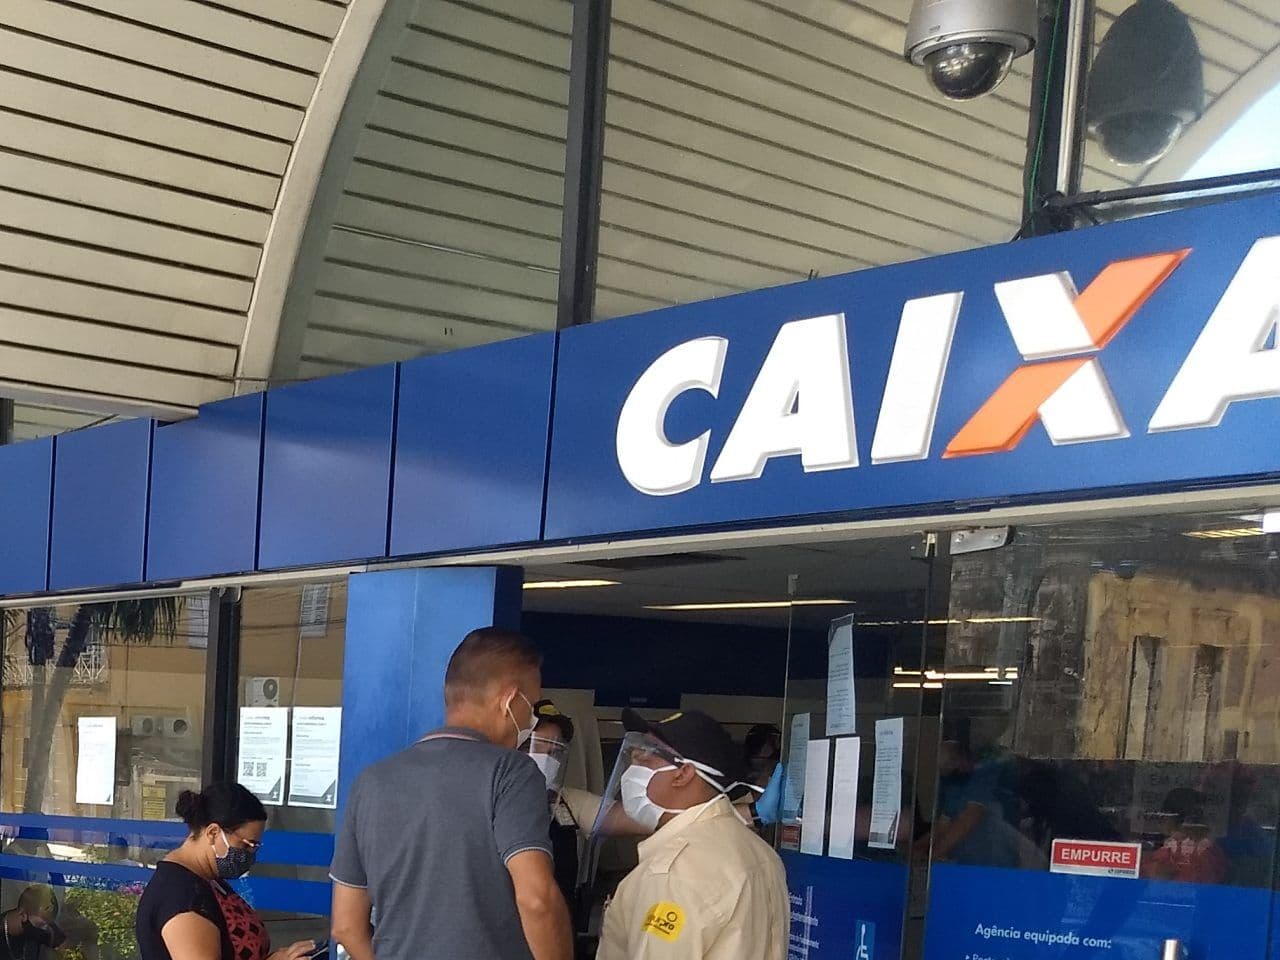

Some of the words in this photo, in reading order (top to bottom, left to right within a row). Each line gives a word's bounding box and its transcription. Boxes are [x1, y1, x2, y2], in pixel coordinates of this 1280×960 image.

[616, 235, 1280, 497] CAIXA
[1061, 847, 1131, 864] EMPURRE
[974, 922, 1021, 939] Agência
[1024, 929, 1080, 946] equipada
[1082, 936, 1112, 949] com:
